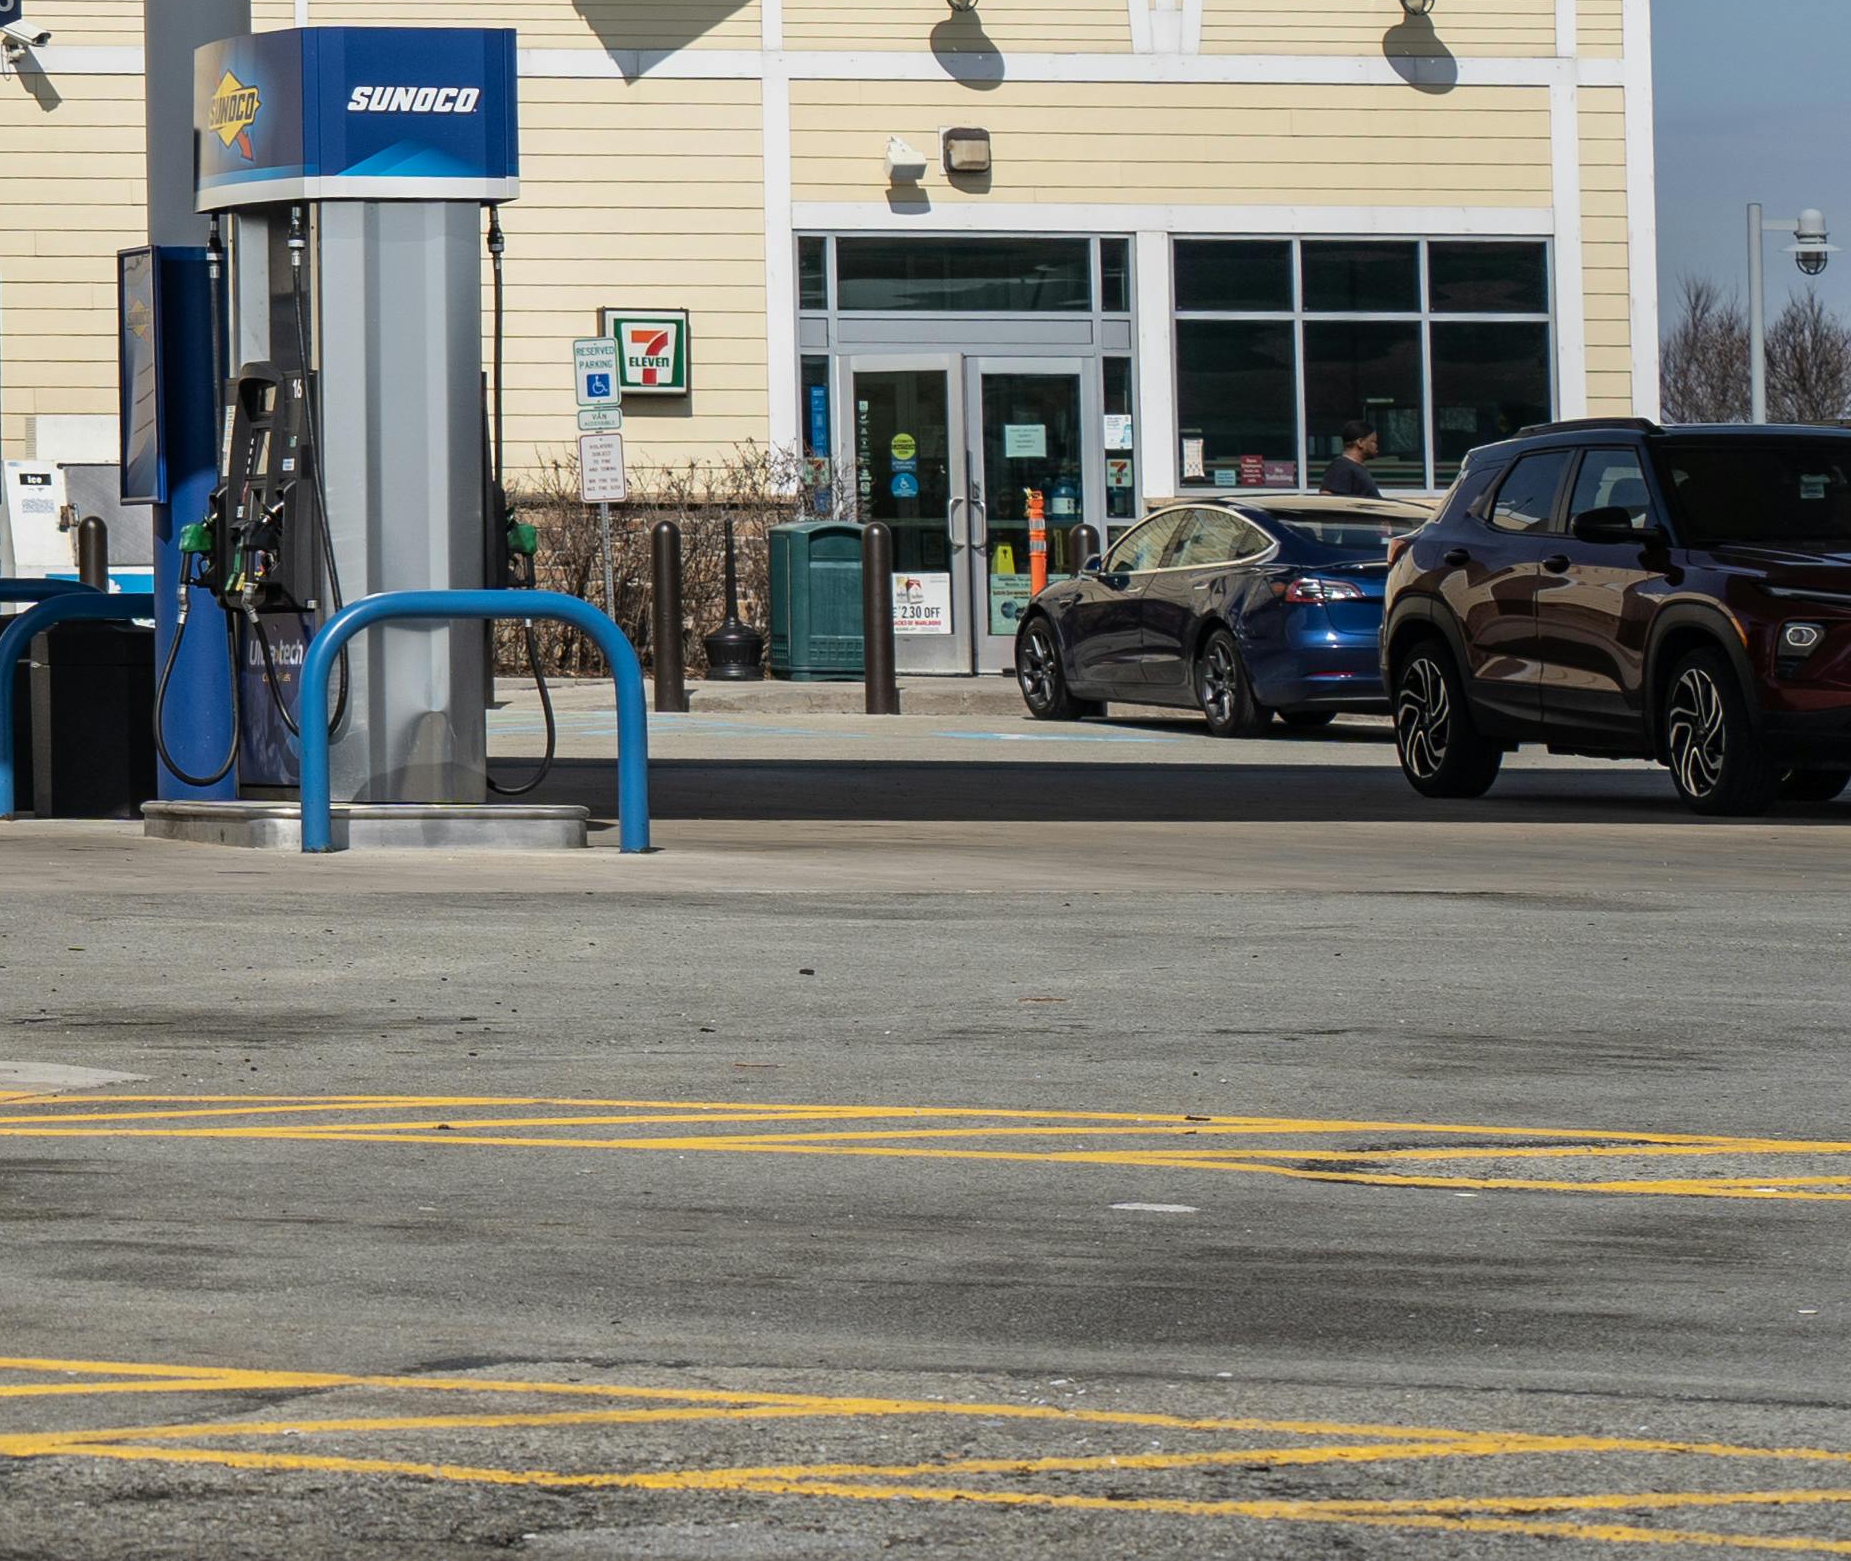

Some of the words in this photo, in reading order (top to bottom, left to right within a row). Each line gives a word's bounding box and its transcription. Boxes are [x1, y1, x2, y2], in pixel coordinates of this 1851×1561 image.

[346, 85, 479, 114] SUNOCO
[576, 345, 615, 357] RESERVED
[578, 359, 613, 370] PARKING
[292, 378, 302, 399] 16
[592, 412, 608, 421] VAN
[924, 606, 941, 619] OFF
